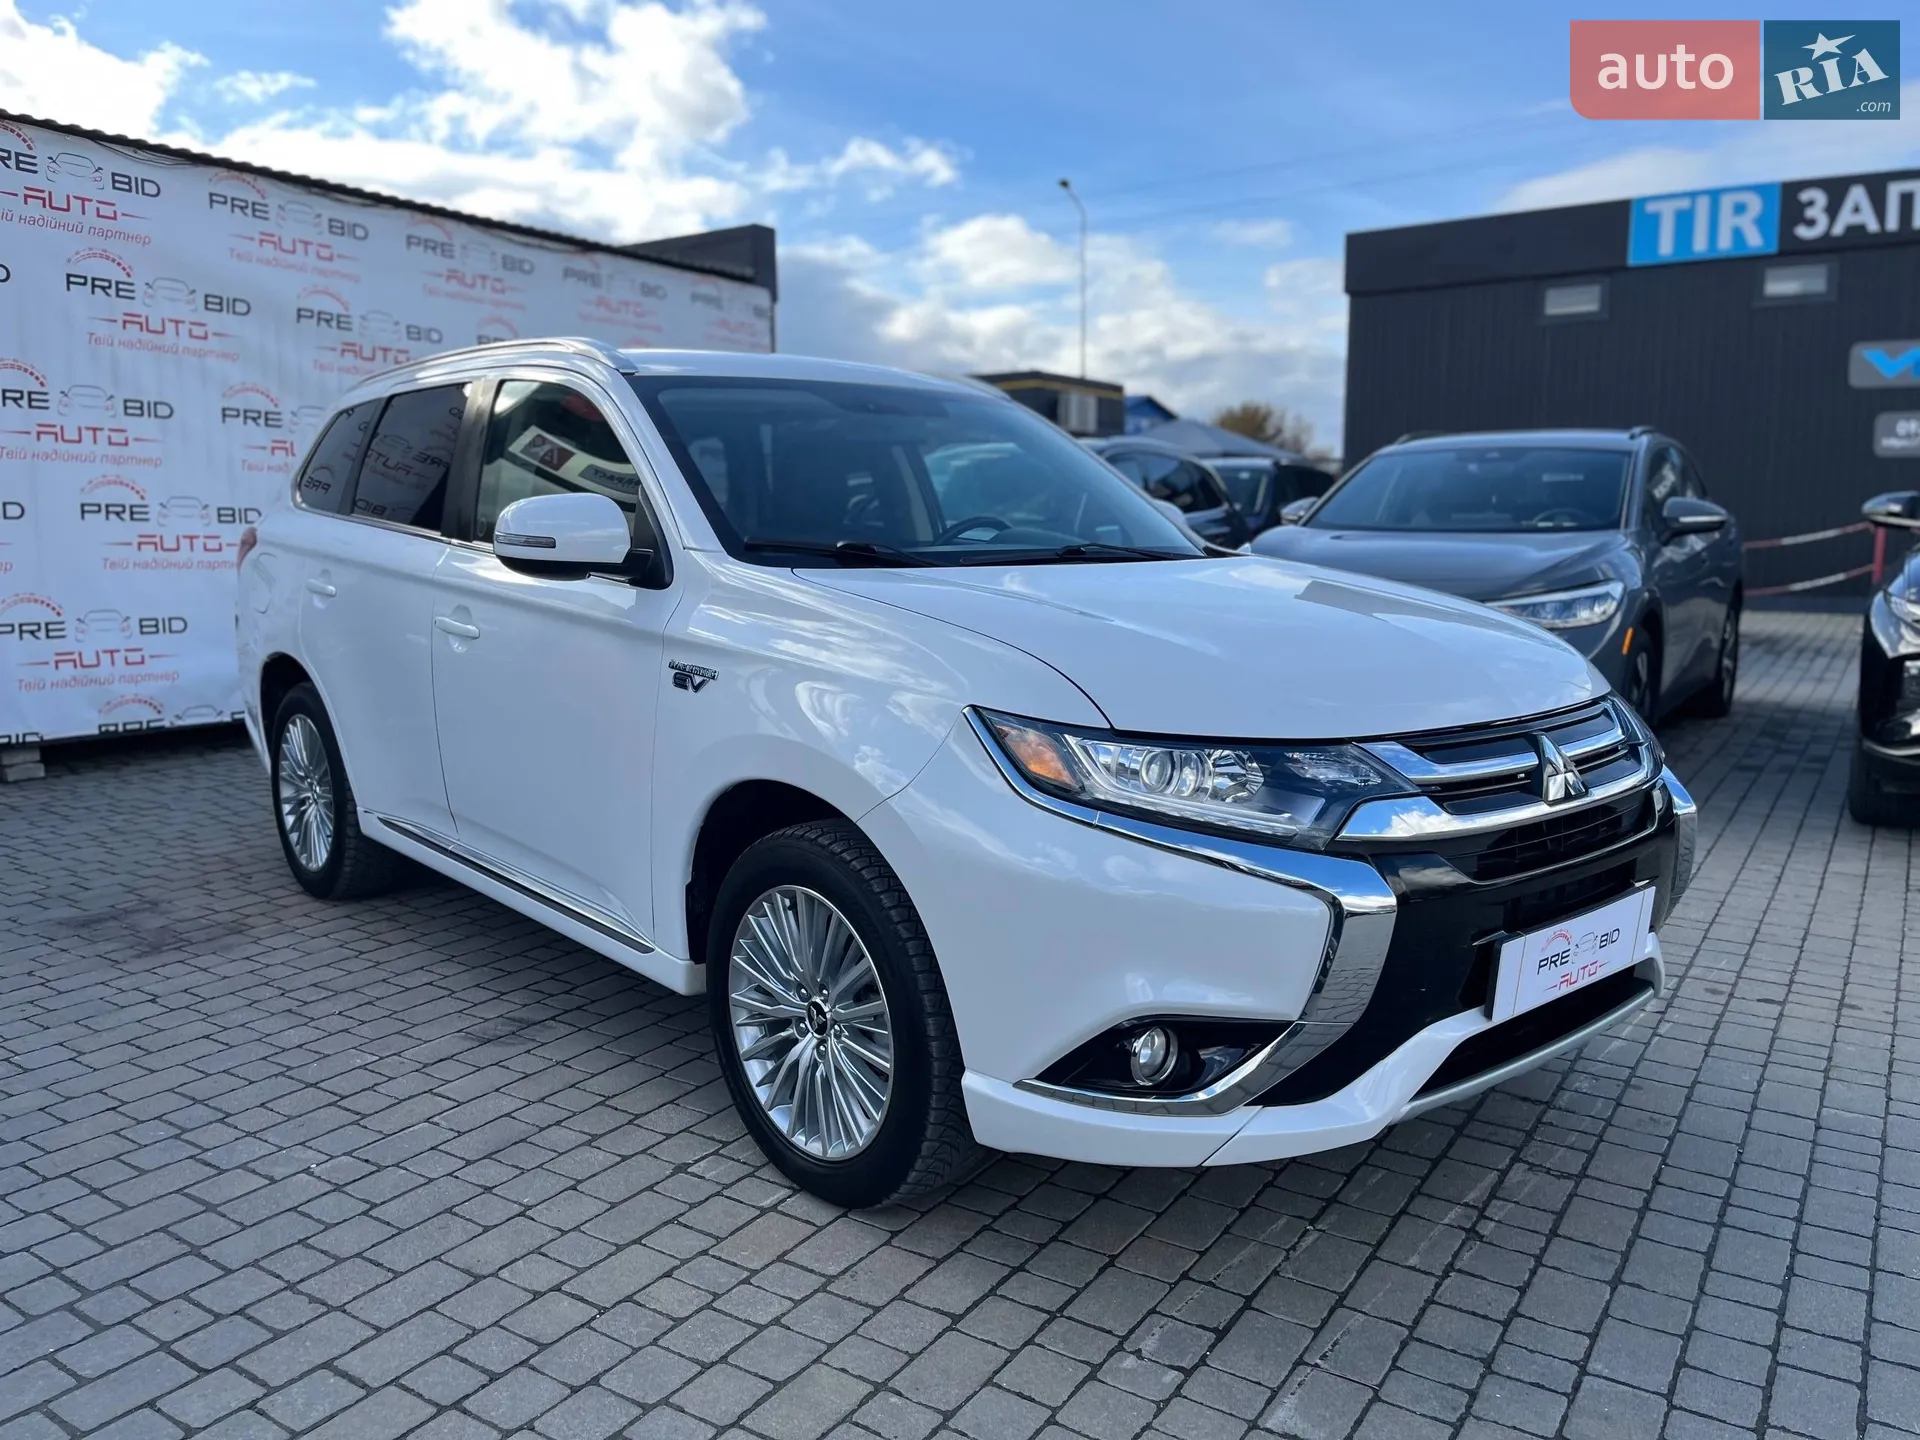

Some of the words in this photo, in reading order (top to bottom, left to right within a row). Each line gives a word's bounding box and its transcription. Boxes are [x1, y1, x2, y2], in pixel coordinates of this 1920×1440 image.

[111, 171, 161, 198] BID
[23, 186, 118, 221] AUTO
[208, 192, 270, 221] PRE
[328, 217, 369, 241] BID
[1645, 190, 1763, 256] TIR
[18, 214, 84, 234] надійний
[88, 226, 151, 247] партнер
[259, 231, 334, 262] AUTO
[406, 233, 455, 260] PRE
[66, 272, 136, 300] PRE
[204, 294, 251, 316] BID
[122, 312, 209, 340] AUTO
[296, 307, 353, 332] PRE
[87, 332, 114, 347] Твій
[117, 337, 179, 354] надійний
[340, 342, 410, 365] AUTO
[123, 398, 174, 420] BID
[221, 407, 282, 428] PRE
[36, 423, 129, 447] AUTO
[31, 449, 96, 464] надійний
[80, 502, 150, 522] PRE
[217, 507, 262, 524] BID
[137, 535, 222, 552] AUTO
[102, 557, 129, 570] Твій
[133, 556, 193, 570] надійний
[196, 560, 236, 572] партн
[0, 621, 67, 641] PRE
[139, 617, 188, 635] BID
[54, 648, 145, 670] AUTO
[17, 678, 46, 692] Твій
[51, 673, 115, 690] надійний
[1537, 948, 1571, 975] PRE
[1599, 928, 1620, 949] BID
[1559, 960, 1599, 990] AUTO
